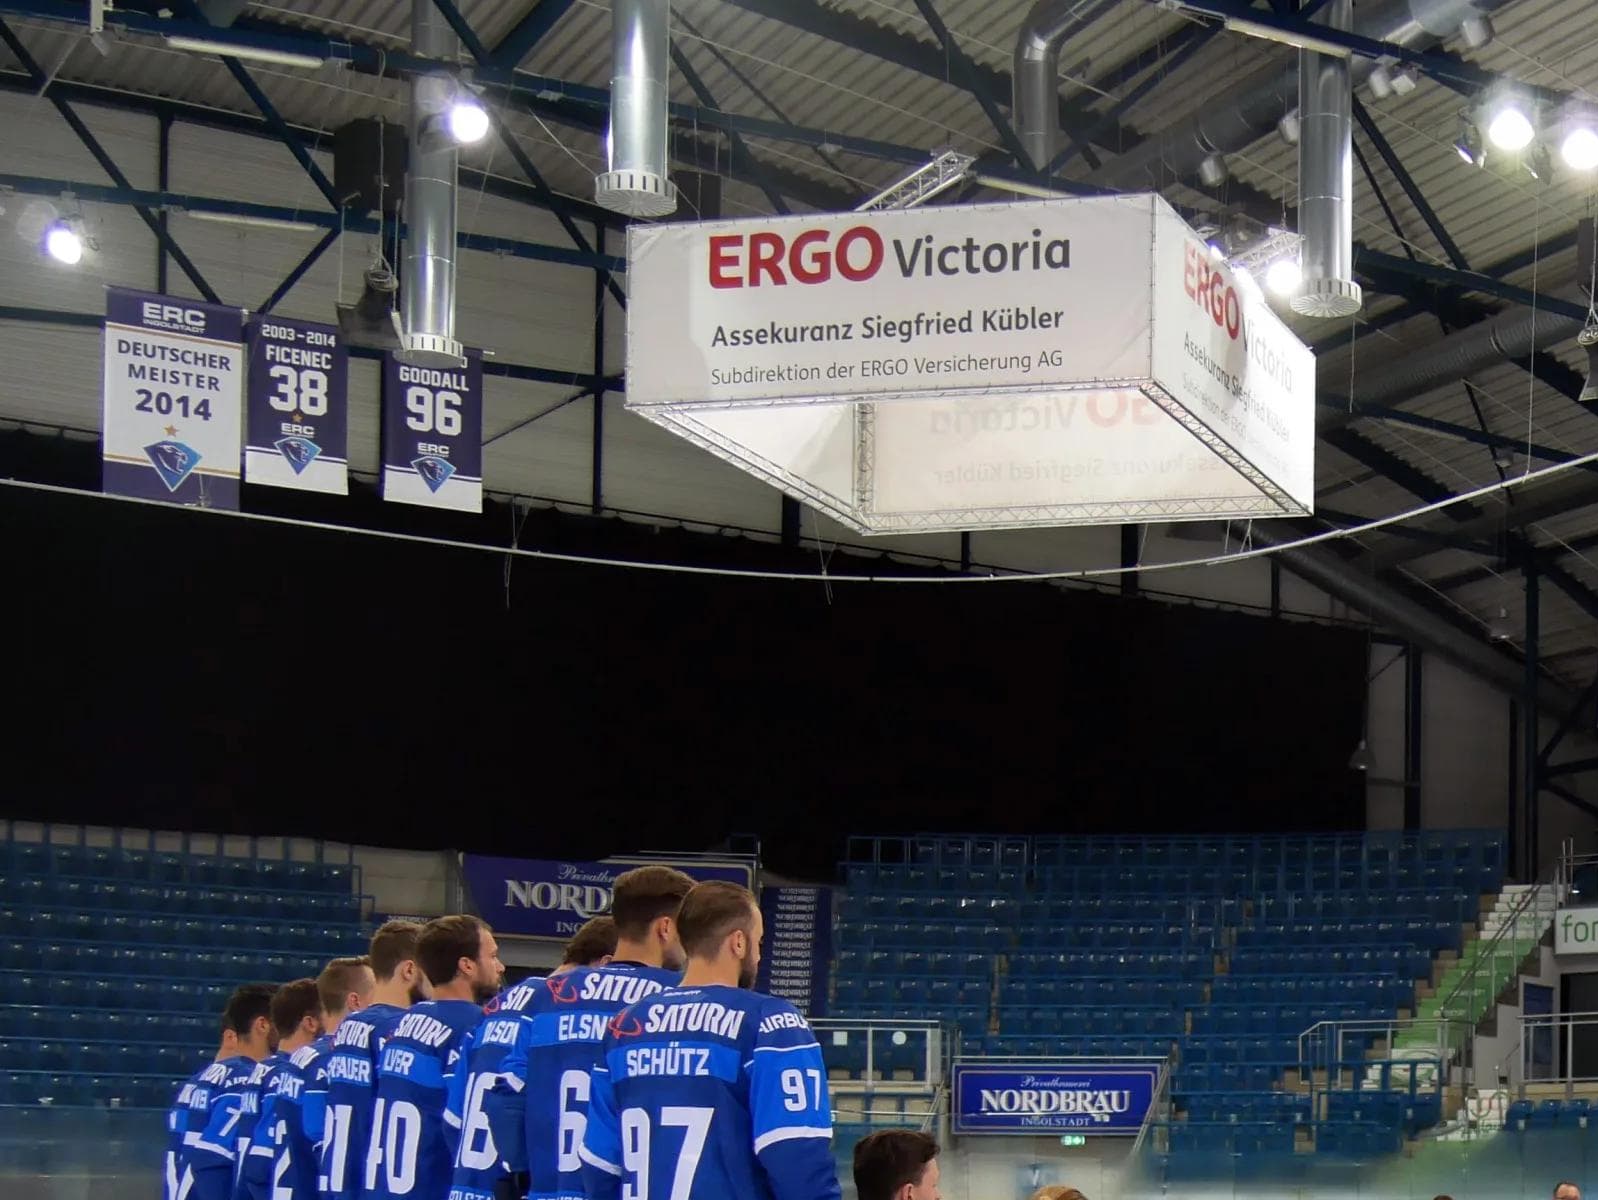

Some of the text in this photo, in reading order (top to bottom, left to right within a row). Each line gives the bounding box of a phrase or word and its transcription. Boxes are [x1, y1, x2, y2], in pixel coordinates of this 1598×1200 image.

[709, 225, 1071, 289] ERGO Victoria
[1184, 237, 1240, 340] ERGO
[143, 302, 206, 327] ERC
[711, 306, 1064, 348] Assekuranz Siegfried Kübler
[262, 324, 336, 347] 2003 2014
[117, 339, 231, 371] DEUTSCHER
[266, 344, 332, 370] FICENEC
[711, 350, 1063, 385] Subdirektion der ERGO Versicherung AG
[128, 363, 220, 391] MEISTER
[269, 365, 328, 416] 38
[400, 366, 470, 391] GOODALL
[135, 388, 212, 420] 2014
[407, 386, 462, 436] 96
[281, 422, 315, 435] ERC
[418, 442, 450, 454] ERC
[504, 878, 614, 918] NORD
[559, 1013, 607, 1041] ELSN
[645, 1003, 746, 1040] SATURN
[627, 1042, 710, 1077] SCHÜTZ
[781, 1068, 821, 1112] 97
[980, 1089, 1131, 1114] NORDBRÄU
[1021, 1117, 1090, 1127] INGOLSTADT
